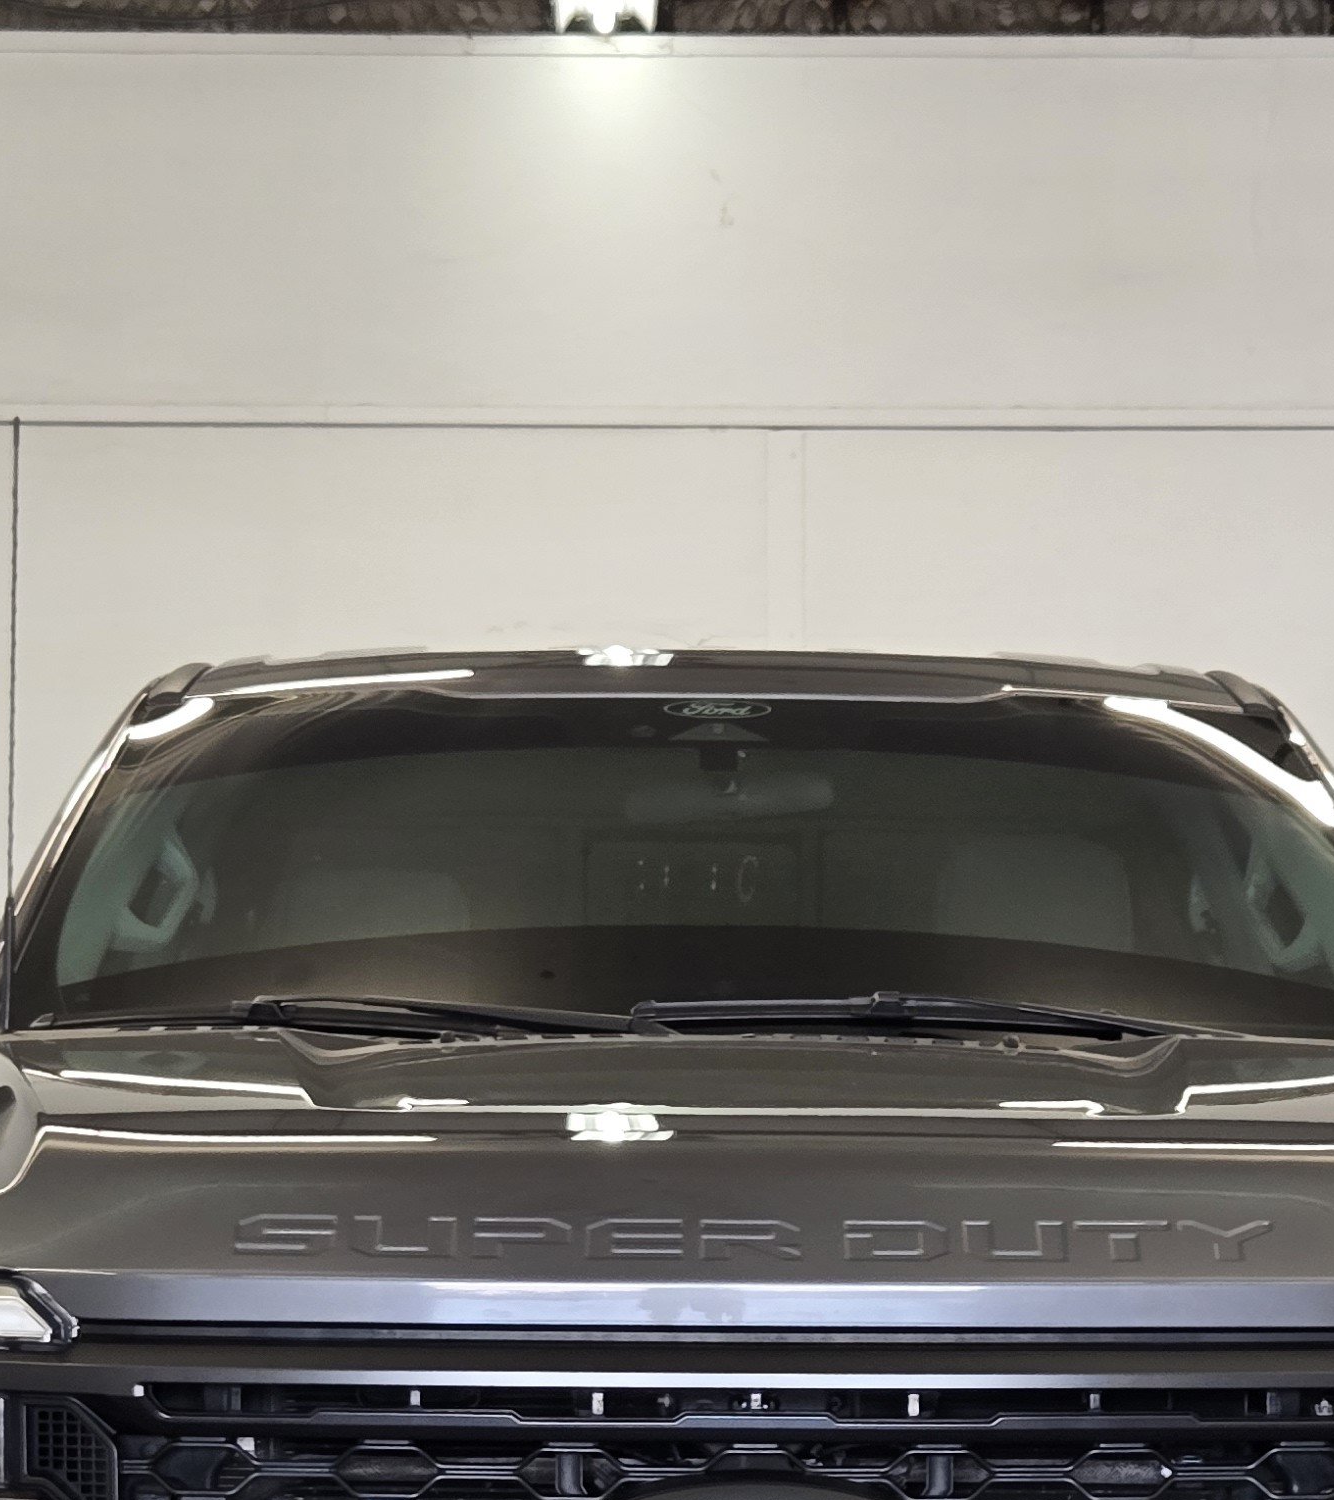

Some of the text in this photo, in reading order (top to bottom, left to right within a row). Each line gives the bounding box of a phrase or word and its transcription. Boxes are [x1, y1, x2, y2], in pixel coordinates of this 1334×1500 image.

[682, 702, 751, 716] Ford
[234, 1213, 1272, 1262] SUPER DUTY
